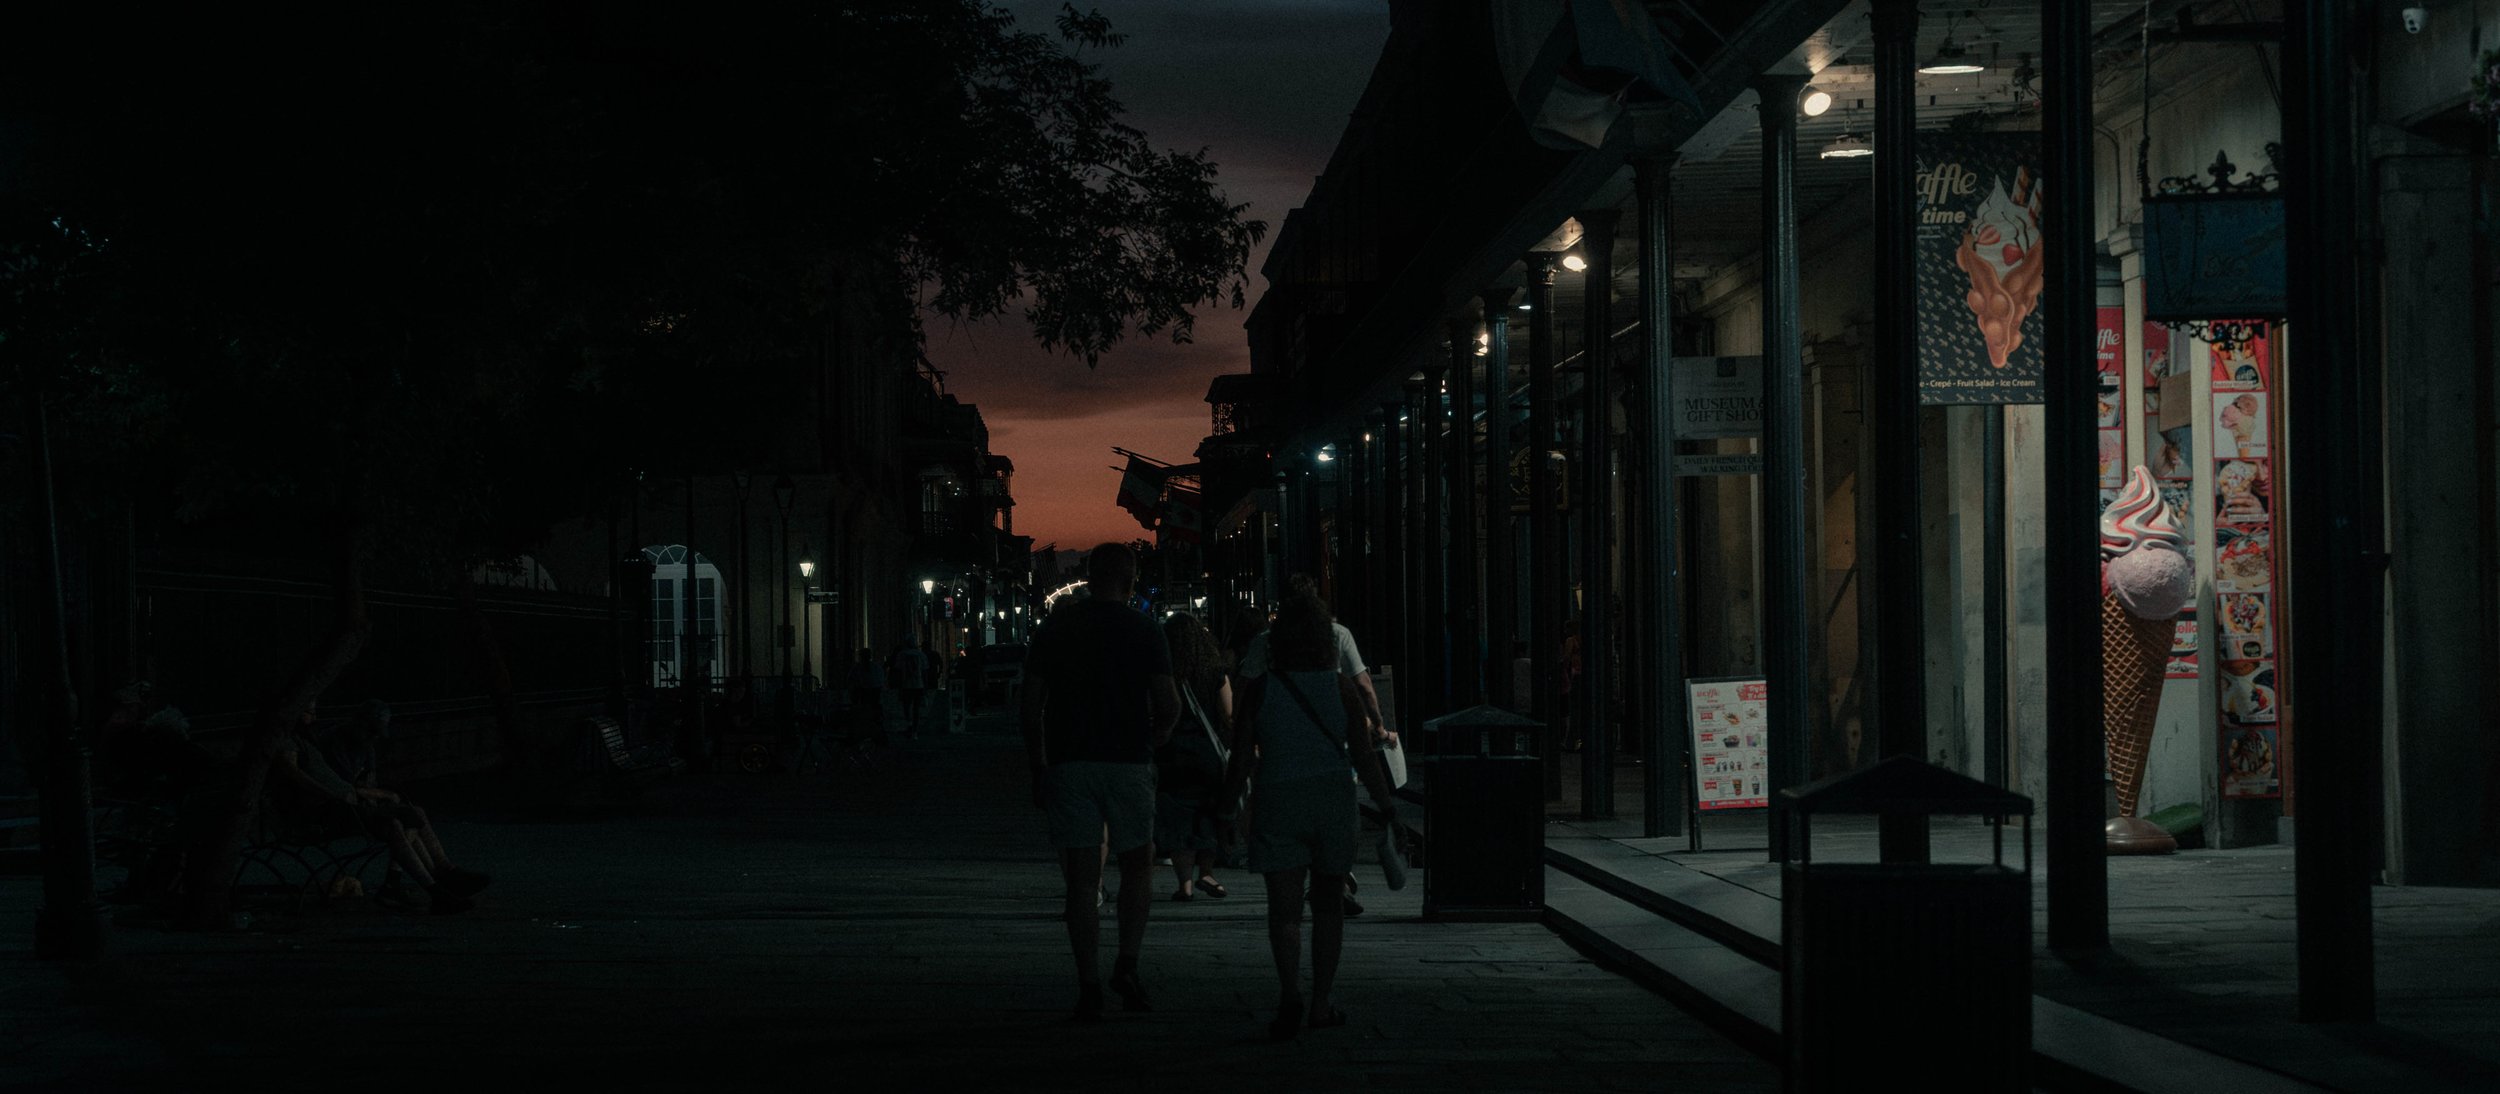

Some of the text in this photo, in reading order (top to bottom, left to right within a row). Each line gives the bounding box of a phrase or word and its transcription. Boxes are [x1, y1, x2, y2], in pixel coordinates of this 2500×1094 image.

[1916, 161, 1978, 205] affle
[1922, 206, 1967, 224] time
[2097, 328, 2121, 351] ffle
[2097, 351, 2115, 359] ime
[1957, 379, 1974, 387] Fruit
[1975, 379, 1995, 387] Salad
[2000, 379, 2011, 387] Ice
[2012, 379, 2036, 387] Cream
[1685, 397, 1755, 410] MUSEUM
[1687, 409, 1764, 422] GIFT SHO
[2177, 620, 2199, 633] ella
